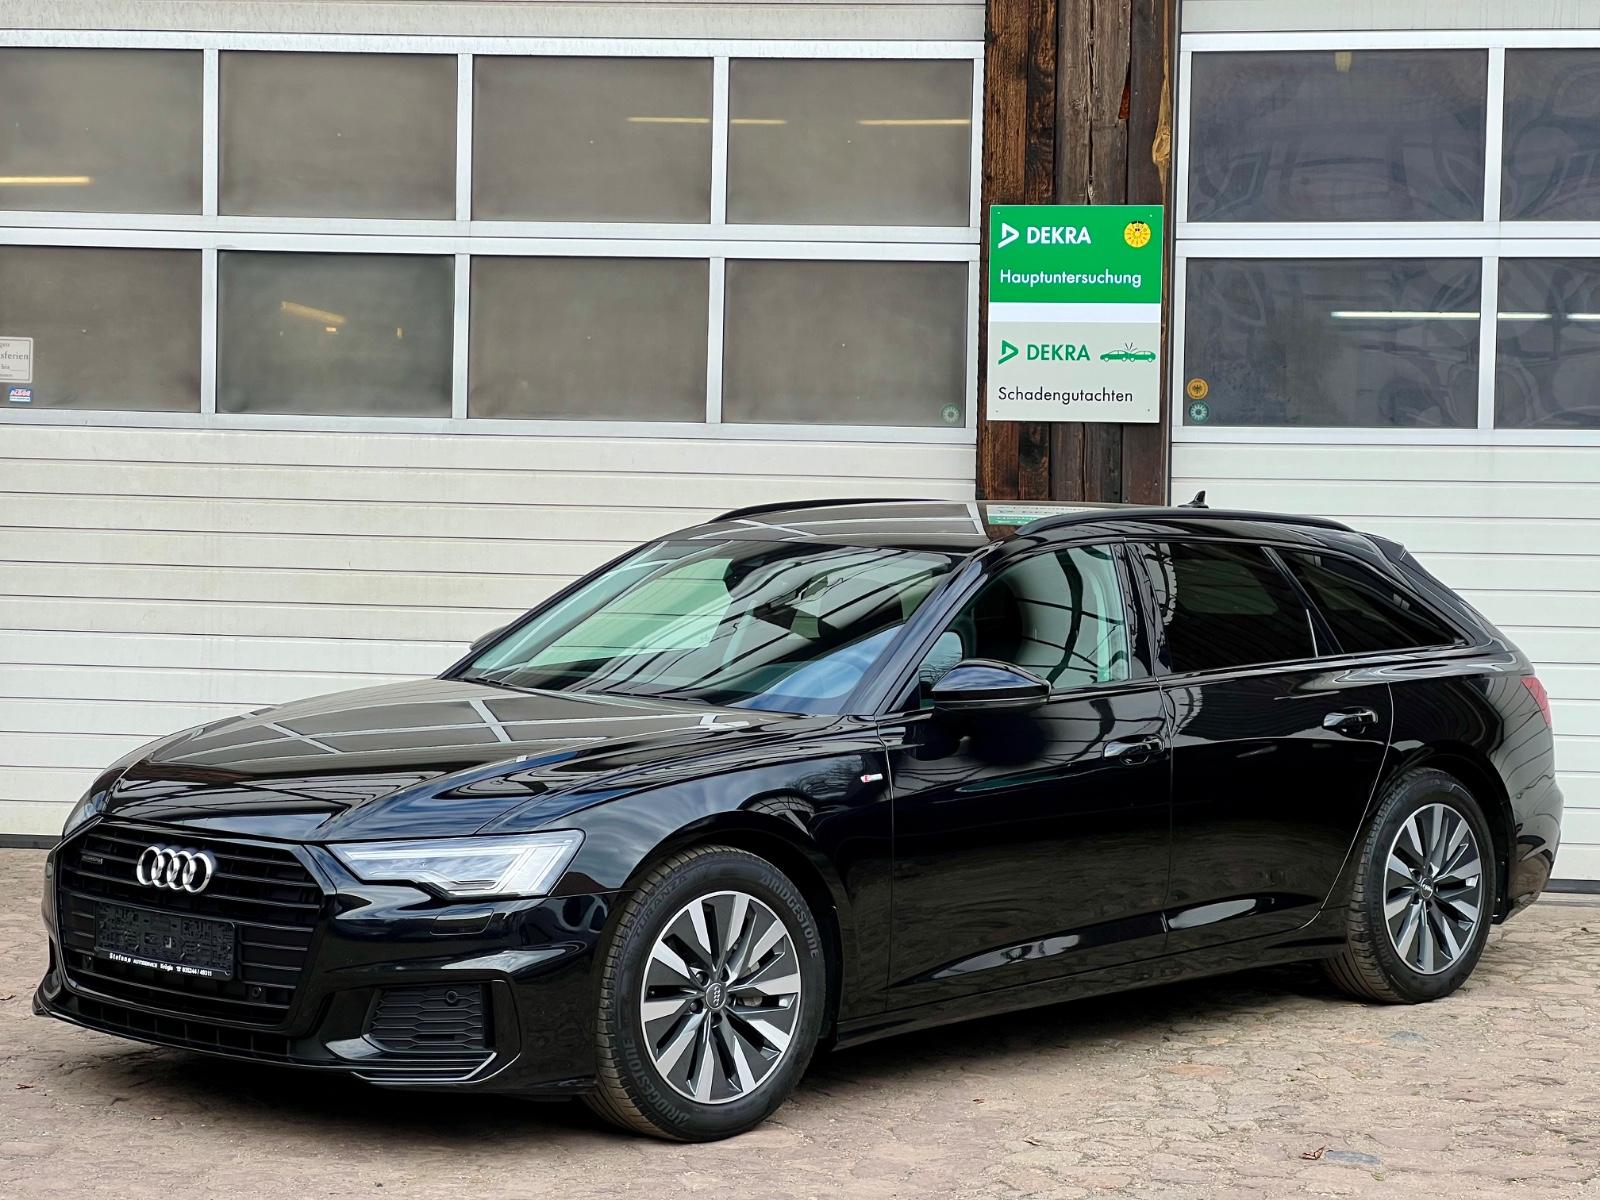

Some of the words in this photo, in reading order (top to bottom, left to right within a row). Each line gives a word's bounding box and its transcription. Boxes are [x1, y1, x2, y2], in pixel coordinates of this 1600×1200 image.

[1027, 226, 1092, 244] DEKRA
[1000, 269, 1142, 288] Hauptuntersuchung
[1027, 344, 1091, 361] DEKRA
[998, 386, 1133, 405] Schadengutachten
[761, 869, 819, 959] BRIDGESTONE
